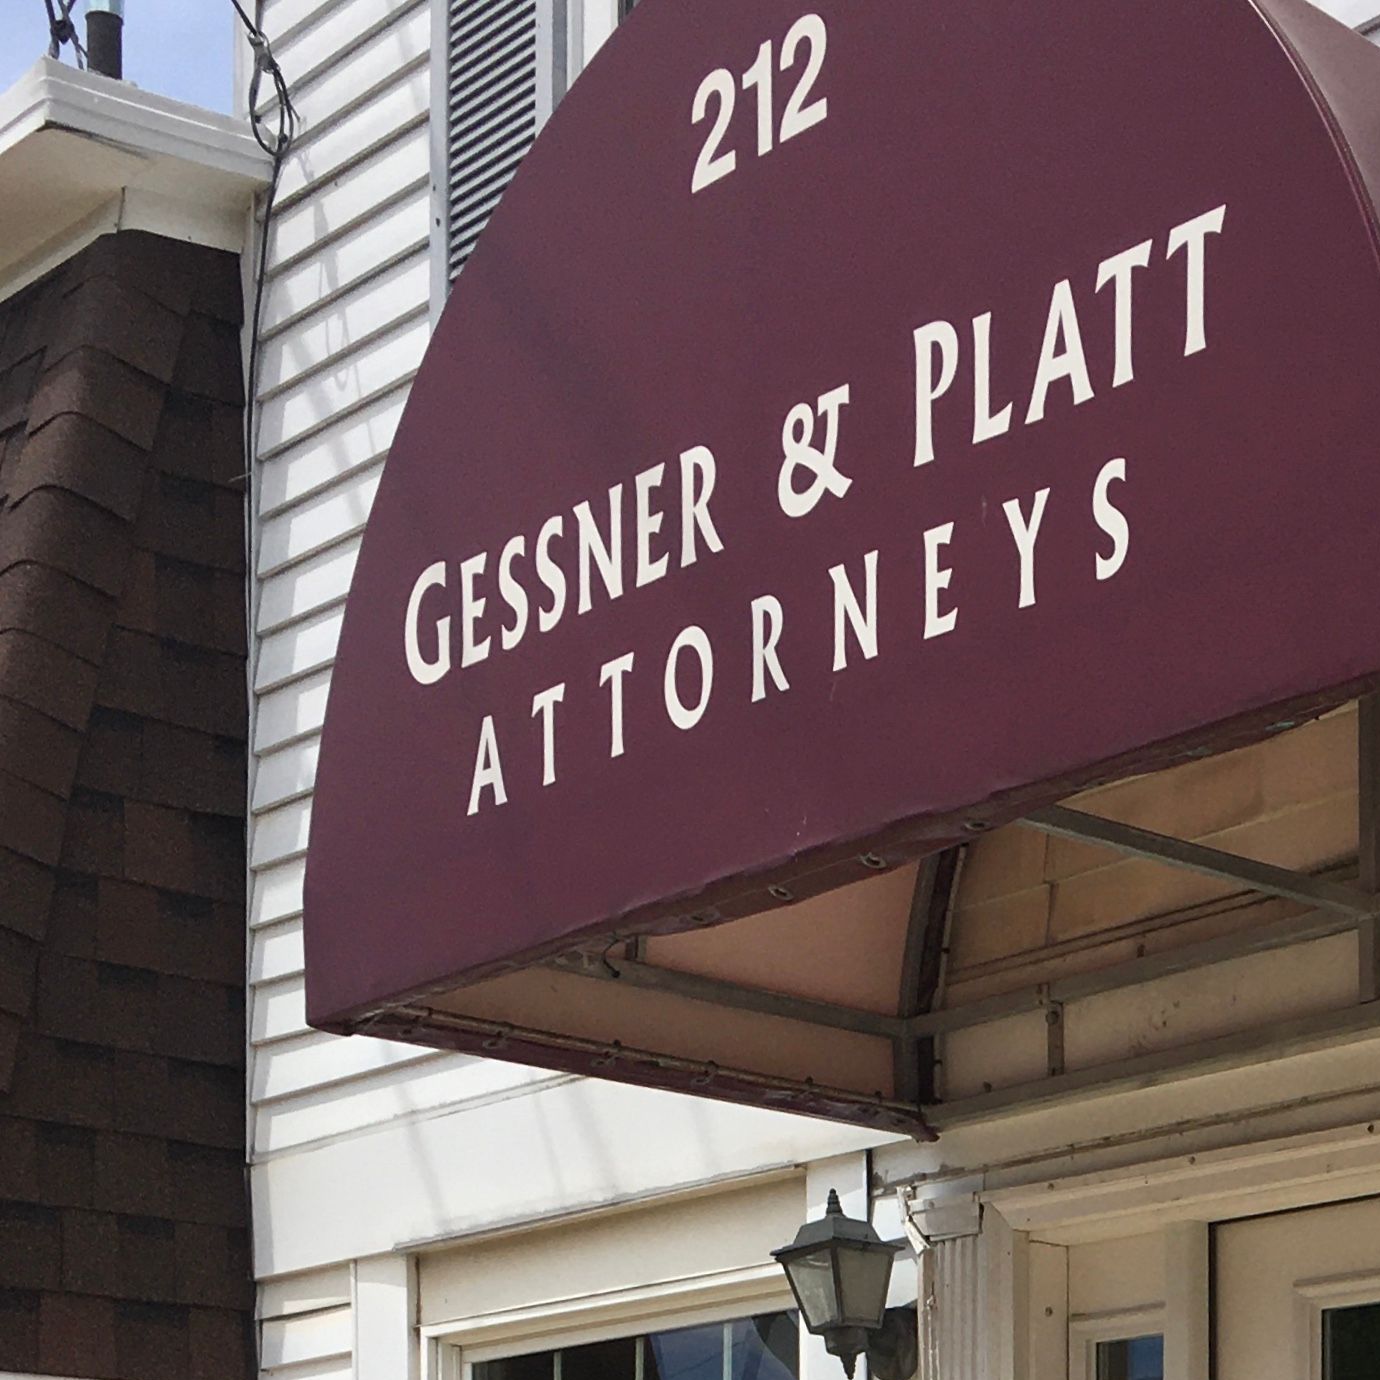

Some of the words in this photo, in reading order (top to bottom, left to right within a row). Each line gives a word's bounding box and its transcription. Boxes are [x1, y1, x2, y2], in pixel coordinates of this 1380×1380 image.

[691, 13, 828, 194] 212
[404, 445, 724, 685] GESSNER
[776, 383, 854, 518] &
[913, 204, 1227, 468] PLATT
[466, 457, 1129, 816] ATTORNEYS
